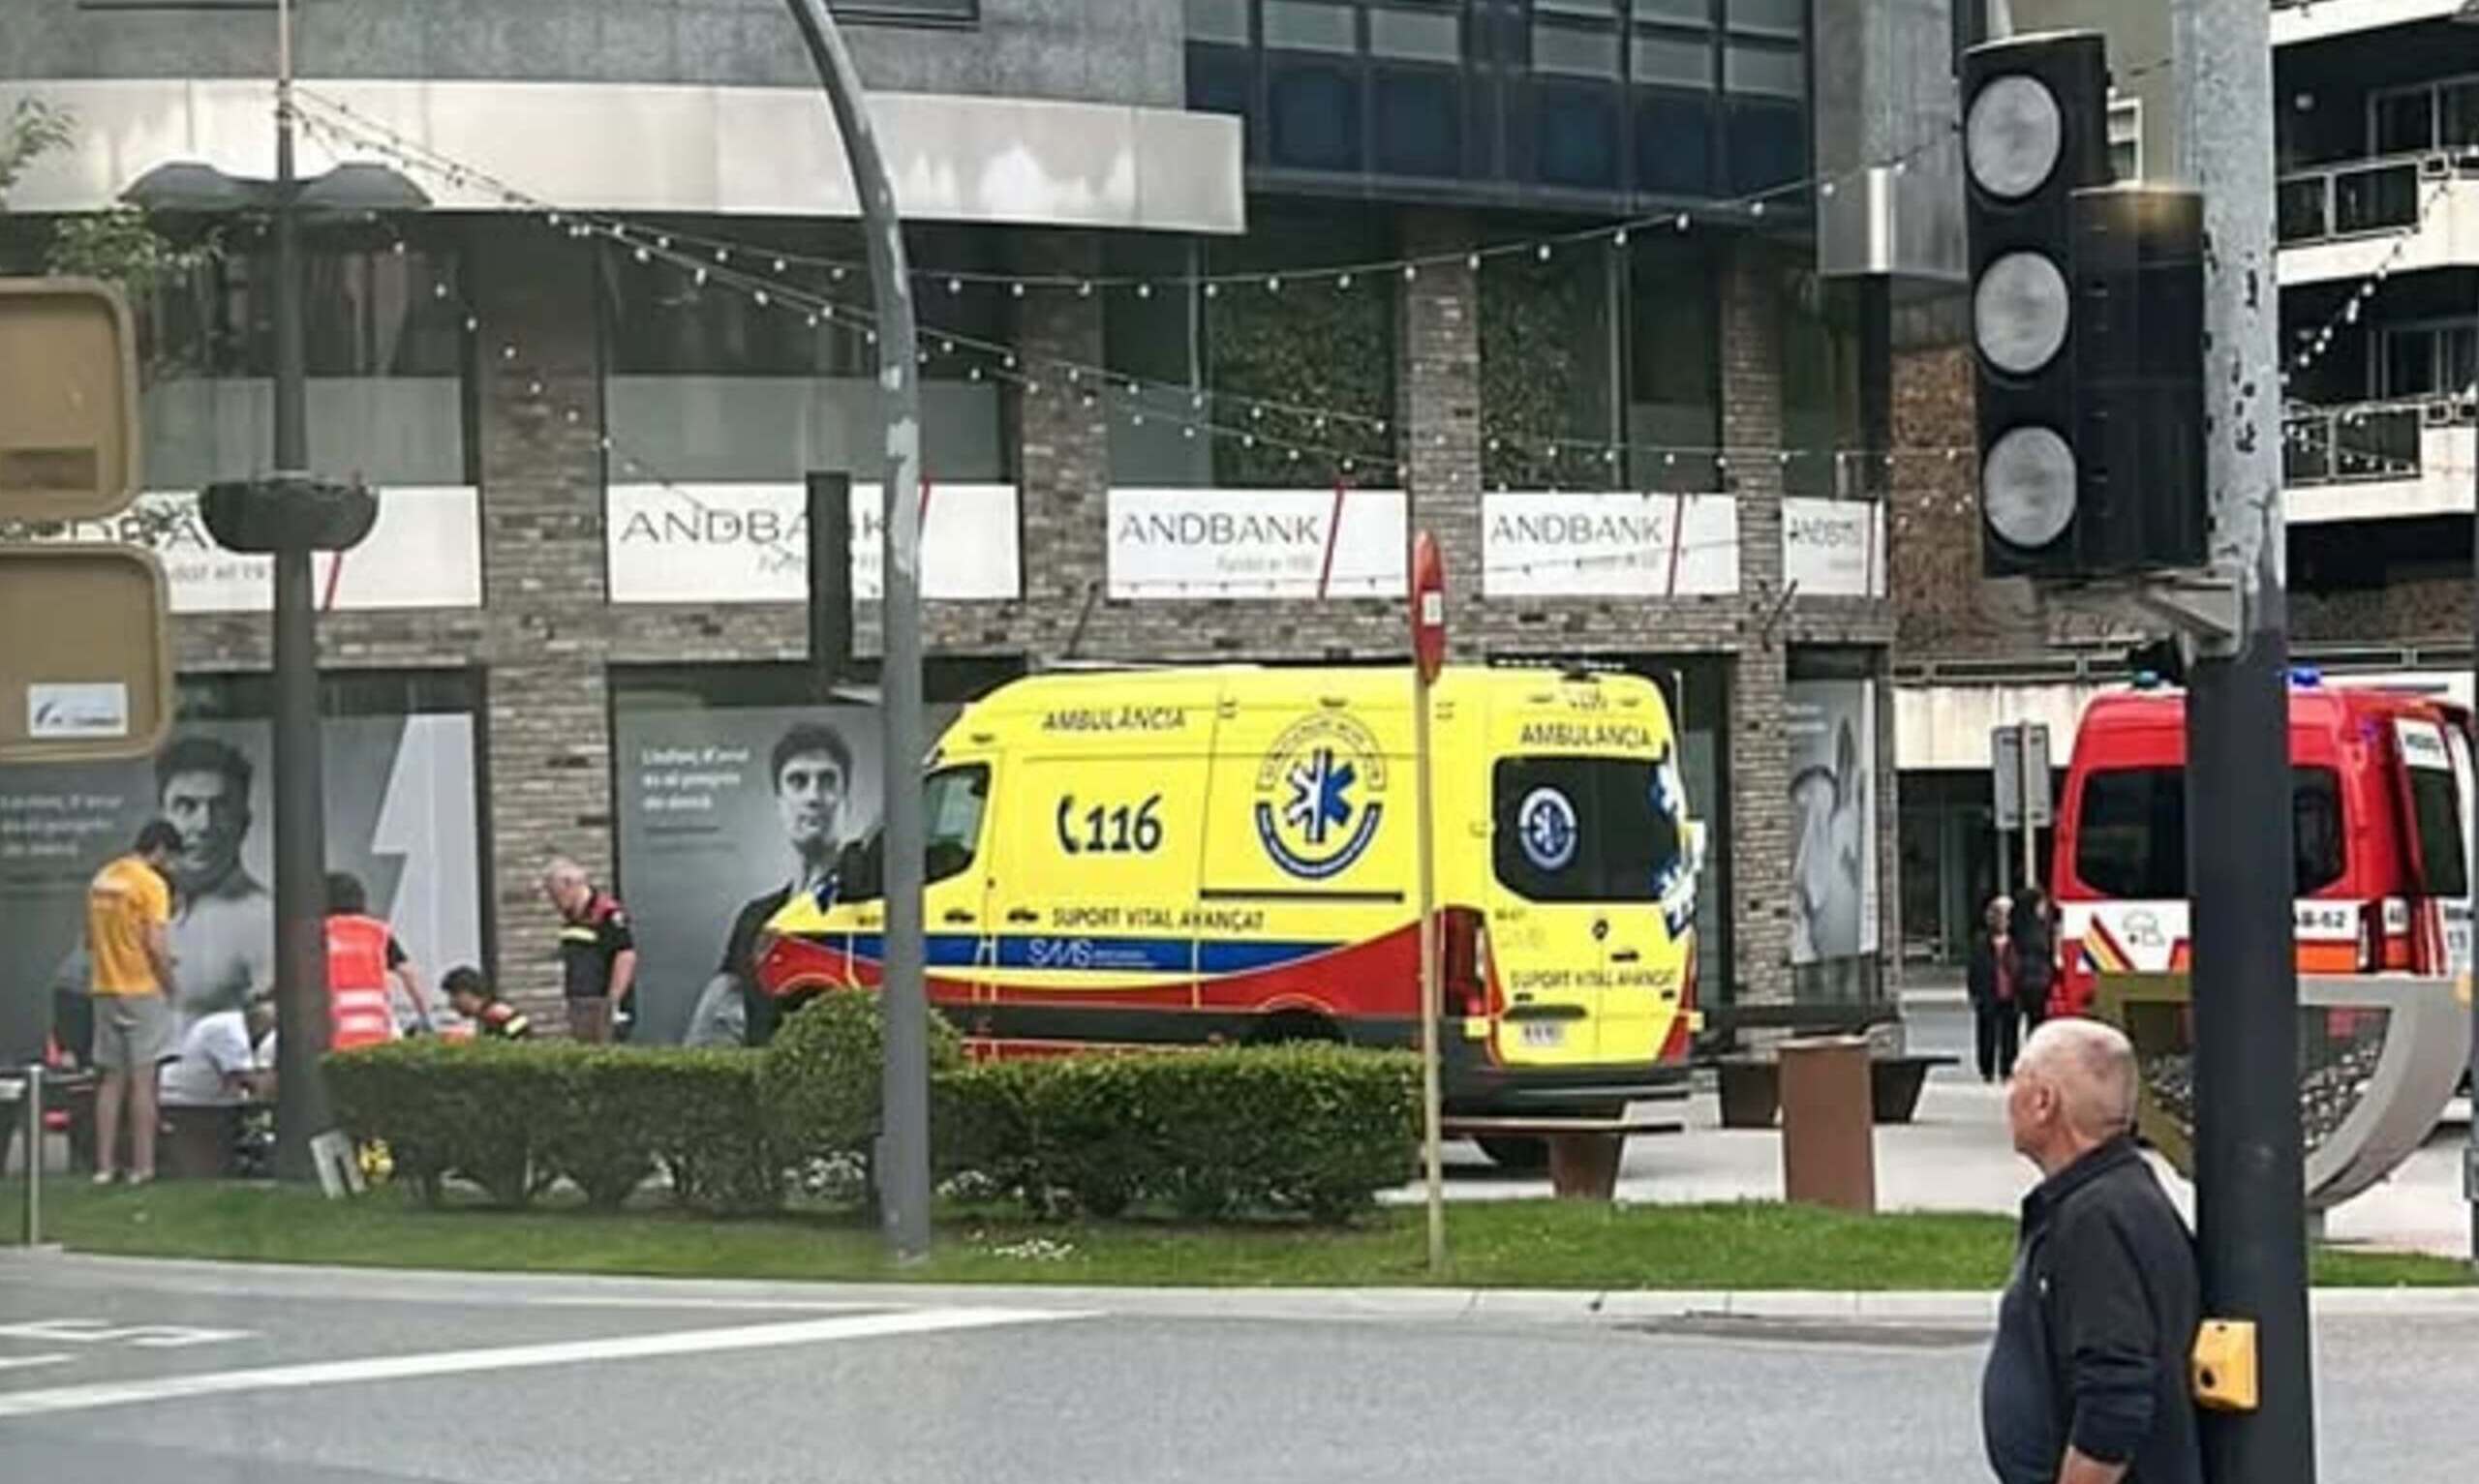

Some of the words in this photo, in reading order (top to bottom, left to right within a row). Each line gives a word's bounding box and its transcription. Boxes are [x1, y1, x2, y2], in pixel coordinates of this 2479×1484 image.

[619, 508, 885, 544] ANDBAK
[1118, 511, 1320, 545] ANDBANK
[1489, 515, 1663, 545] ANDBANK
[1085, 792, 1164, 853] 116
[1053, 906, 1119, 928] SUPORT
[1125, 907, 1174, 929] VITAL
